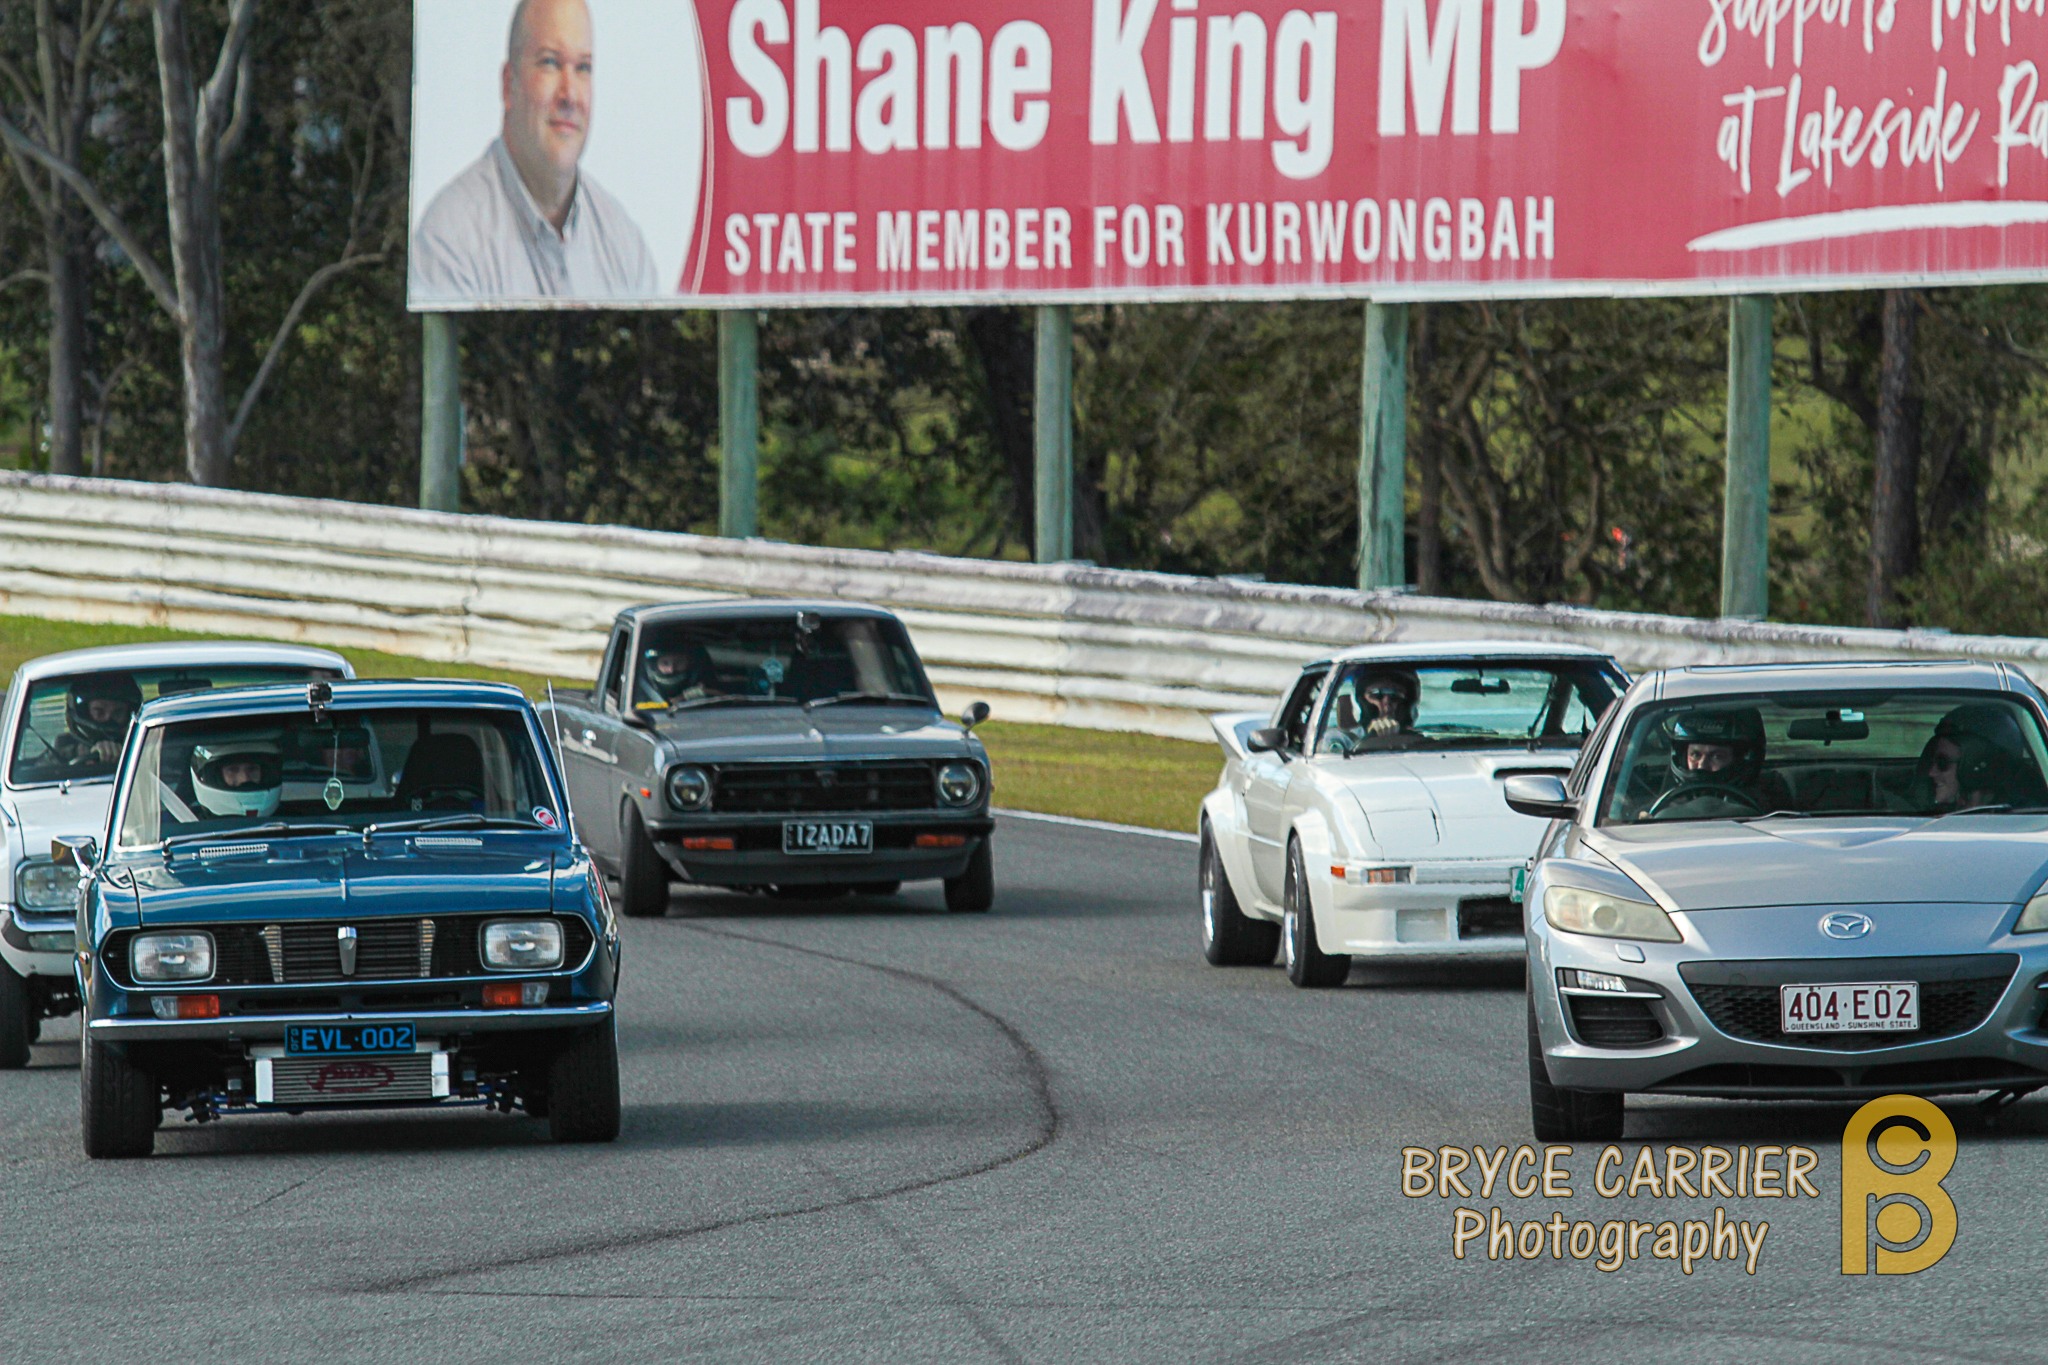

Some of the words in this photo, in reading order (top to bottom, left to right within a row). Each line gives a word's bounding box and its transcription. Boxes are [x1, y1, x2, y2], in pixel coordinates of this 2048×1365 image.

[725, 0, 1053, 158] Shane
[1089, 0, 1338, 179] King
[1378, 0, 1567, 136] MP
[1717, 85, 1787, 194] at
[1775, 65, 1981, 198] Lakeside
[725, 211, 858, 276] STATE
[876, 207, 1072, 272] MEMBER
[1094, 203, 1185, 269] FOR
[1206, 197, 1555, 267] KURWONGBAH
[1791, 1022, 1840, 1031] QUEENSLAND
[1847, 1021, 1885, 1030] SUNSHINE
[1889, 1020, 1912, 1029] STATE
